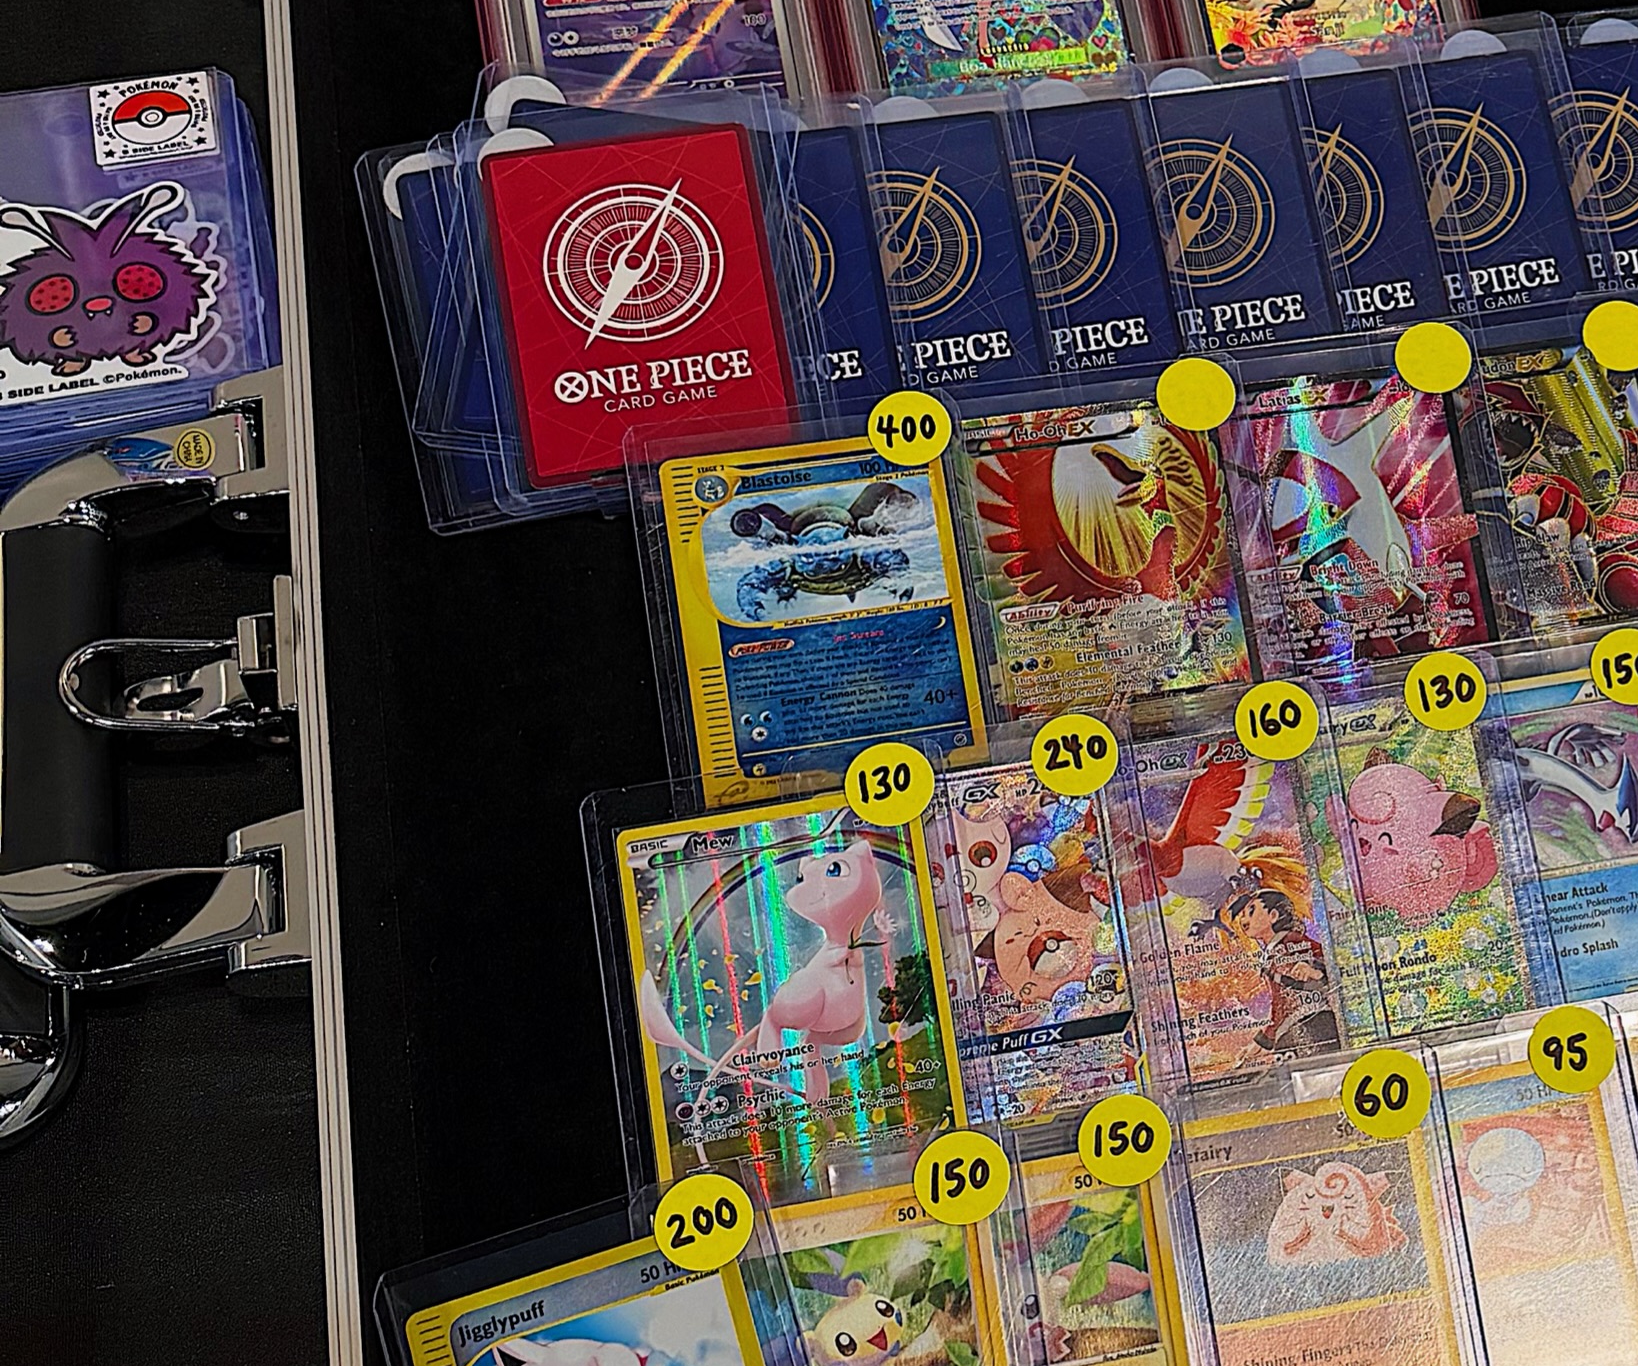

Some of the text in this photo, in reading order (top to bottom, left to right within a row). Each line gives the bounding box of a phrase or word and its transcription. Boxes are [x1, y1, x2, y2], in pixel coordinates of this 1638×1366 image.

[1473, 258, 1561, 295] PIECE
[1215, 294, 1305, 332] PIECE
[915, 332, 1013, 370] PIECE
[1052, 318, 1149, 355] PIECE
[8, 385, 45, 399] SIDE
[49, 378, 99, 393] LABEL
[554, 349, 752, 403] ONE PIECE
[604, 385, 718, 413] CARD GAME
[876, 415, 935, 447] 400
[741, 470, 812, 489] Blastoise
[1417, 674, 1474, 710] 130
[1249, 706, 1300, 736] 160
[1044, 735, 1107, 770] 240
[858, 764, 910, 801] 130
[692, 835, 733, 852] Mew
[732, 1044, 814, 1067] Clairvoyance
[1543, 1034, 1587, 1071] 95
[738, 1088, 785, 1107] Psychic
[1355, 1074, 1408, 1116] 60
[1094, 1121, 1154, 1157] 150
[930, 1158, 989, 1202] 150
[666, 1197, 737, 1249] 200
[457, 1300, 545, 1346] Jigglypuff
